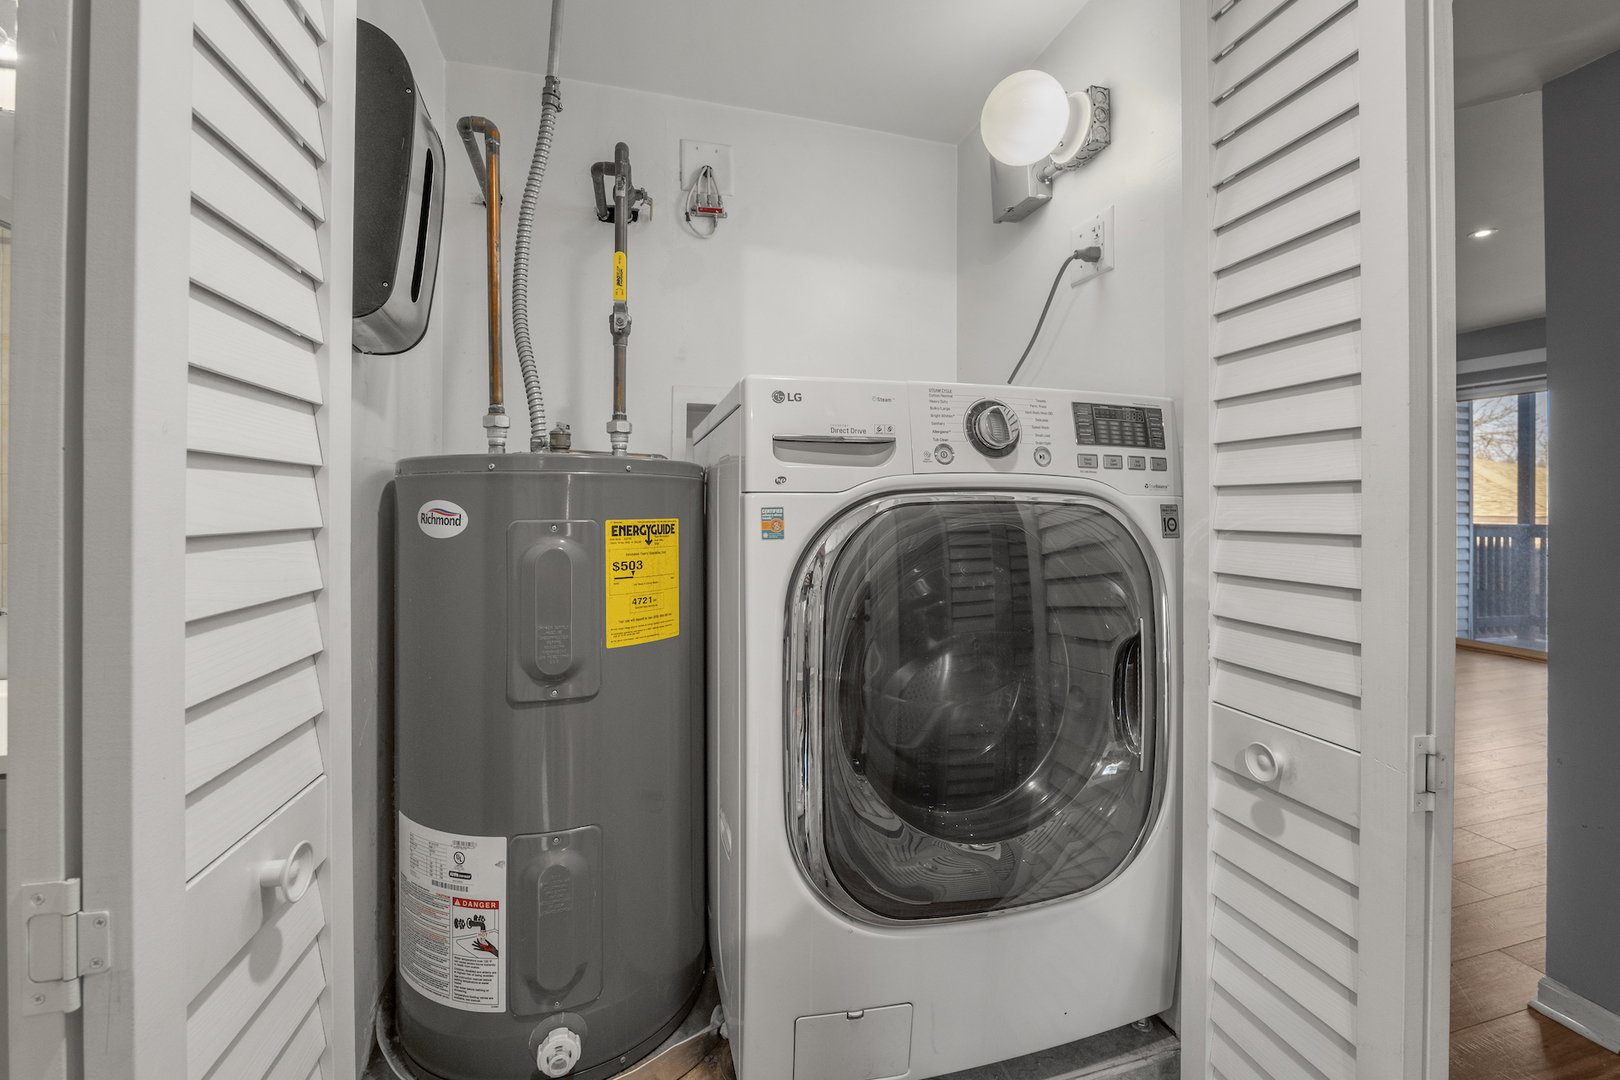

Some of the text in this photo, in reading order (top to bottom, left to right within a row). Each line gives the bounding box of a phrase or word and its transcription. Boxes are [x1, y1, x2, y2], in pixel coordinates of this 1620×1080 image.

[787, 392, 802, 402] LG
[420, 512, 461, 526] Richmond
[1163, 517, 1177, 532] 10
[611, 524, 675, 536] ENERGYGUIDE
[612, 560, 643, 572] $503
[632, 596, 652, 605] 4721
[462, 900, 496, 908] DANGER
